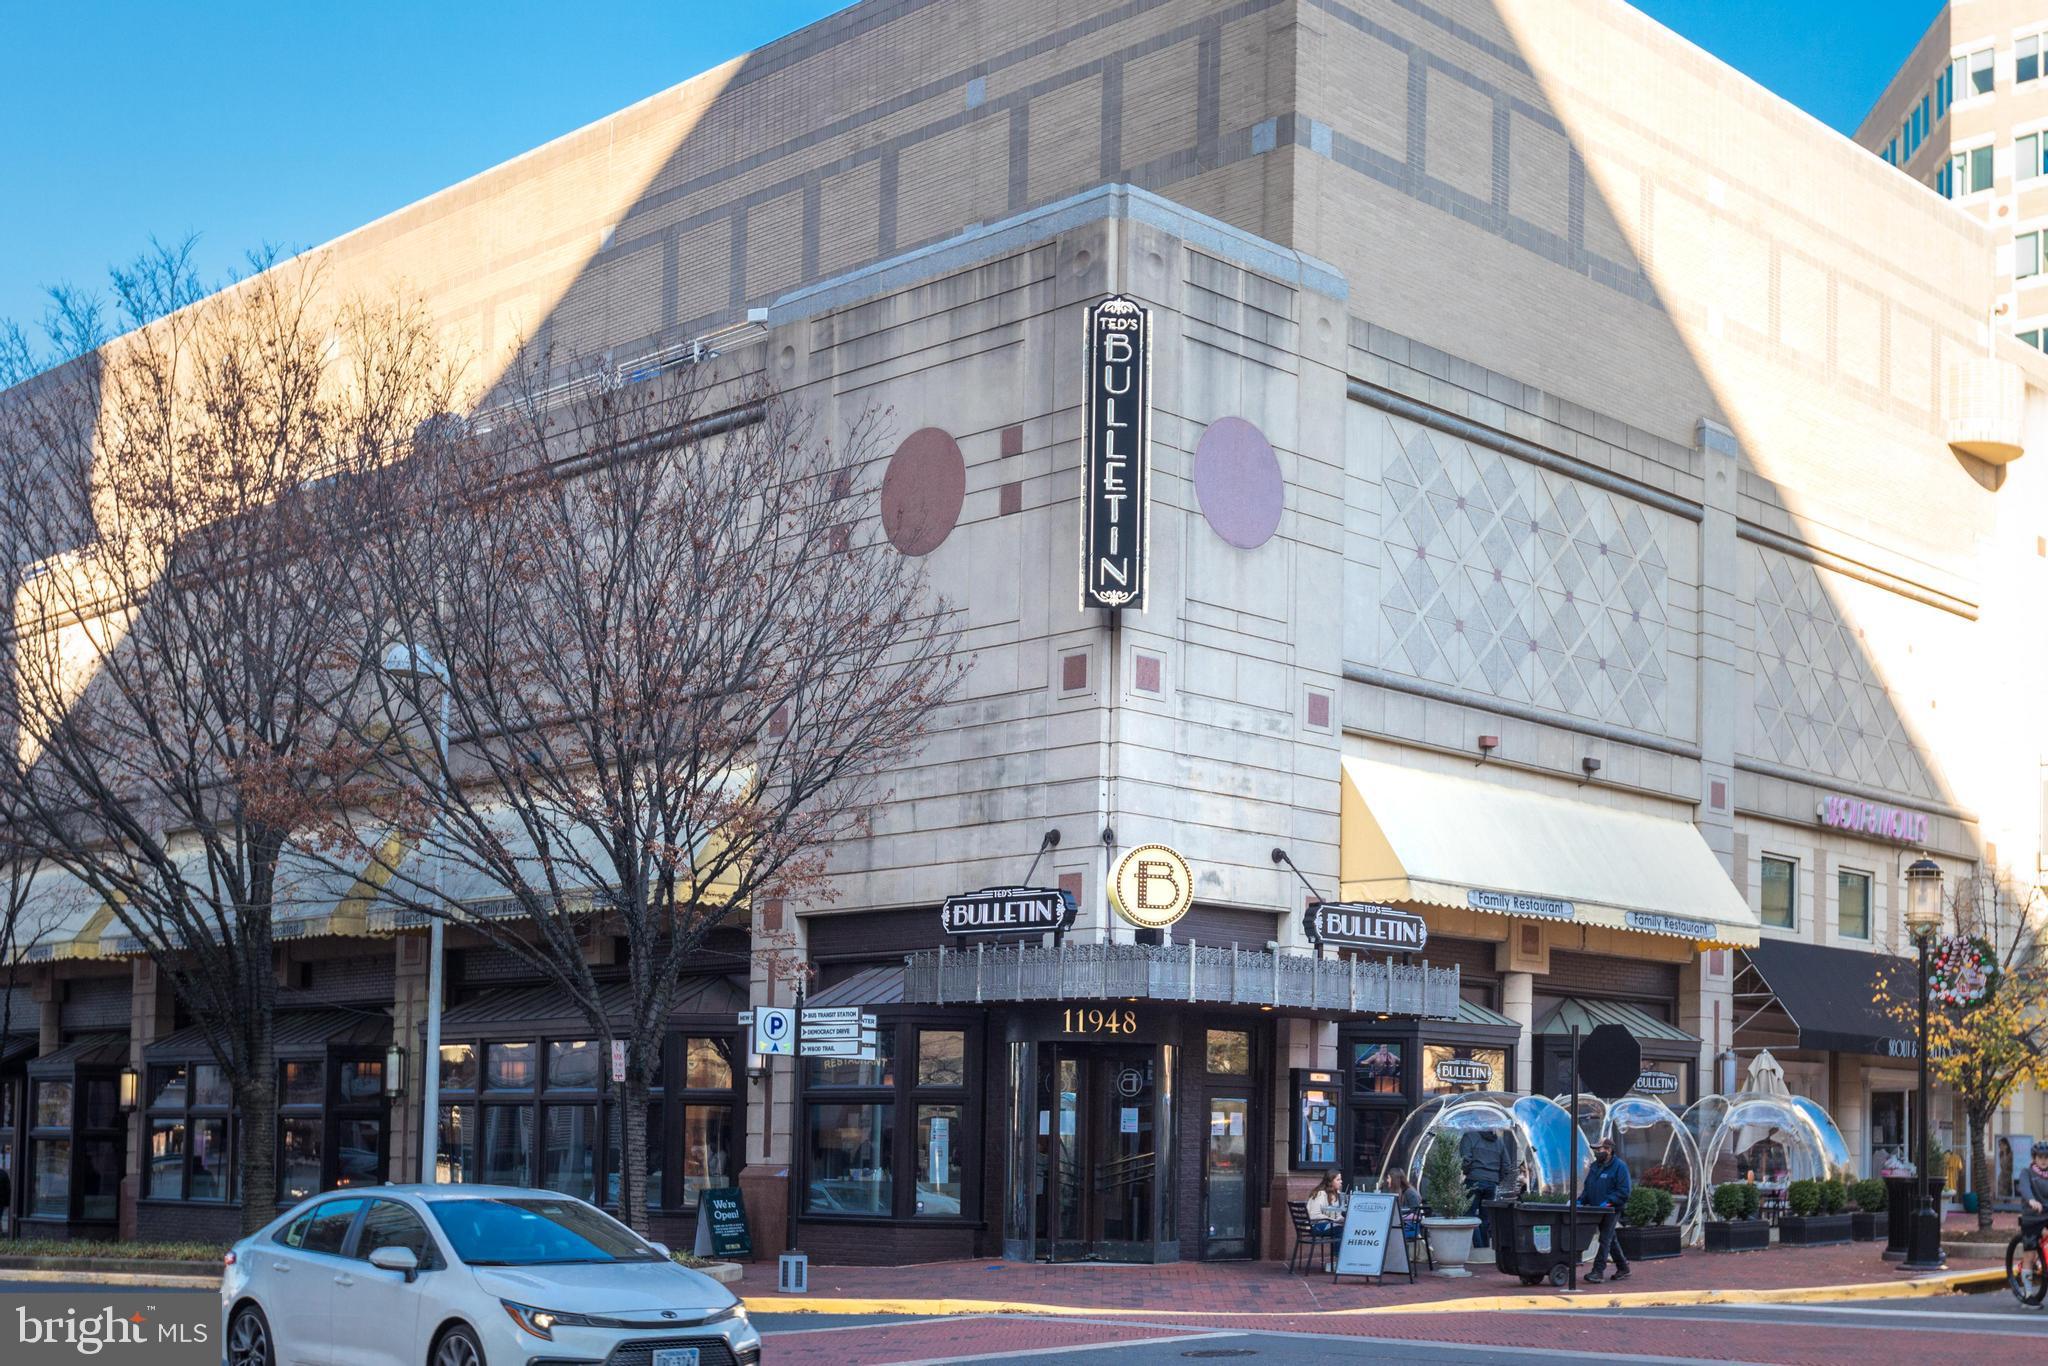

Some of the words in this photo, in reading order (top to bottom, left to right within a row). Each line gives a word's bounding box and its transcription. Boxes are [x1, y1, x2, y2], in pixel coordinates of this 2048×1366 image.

[1100, 317, 1139, 331] TED'S
[1100, 333, 1132, 586] BULLETIN
[1134, 860, 1180, 909] B
[993, 889, 1013, 898] TED'S
[1364, 904, 1381, 914] TED'S
[1478, 892, 1511, 912] Family
[1513, 896, 1564, 915] Restaurant
[953, 900, 1051, 926] BULLETIN
[1327, 913, 1417, 943] BULLETIN
[1634, 913, 1661, 931] Family
[1664, 916, 1708, 935] Restaurant
[770, 1017, 783, 1035] P
[1063, 1009, 1137, 1034] 11948
[1442, 1065, 1487, 1079] BULLETIN
[1636, 1077, 1674, 1089] BULLETIN
[713, 1200, 737, 1209] We're
[714, 1209, 740, 1221] Open!
[1347, 1239, 1380, 1247] HIRING
